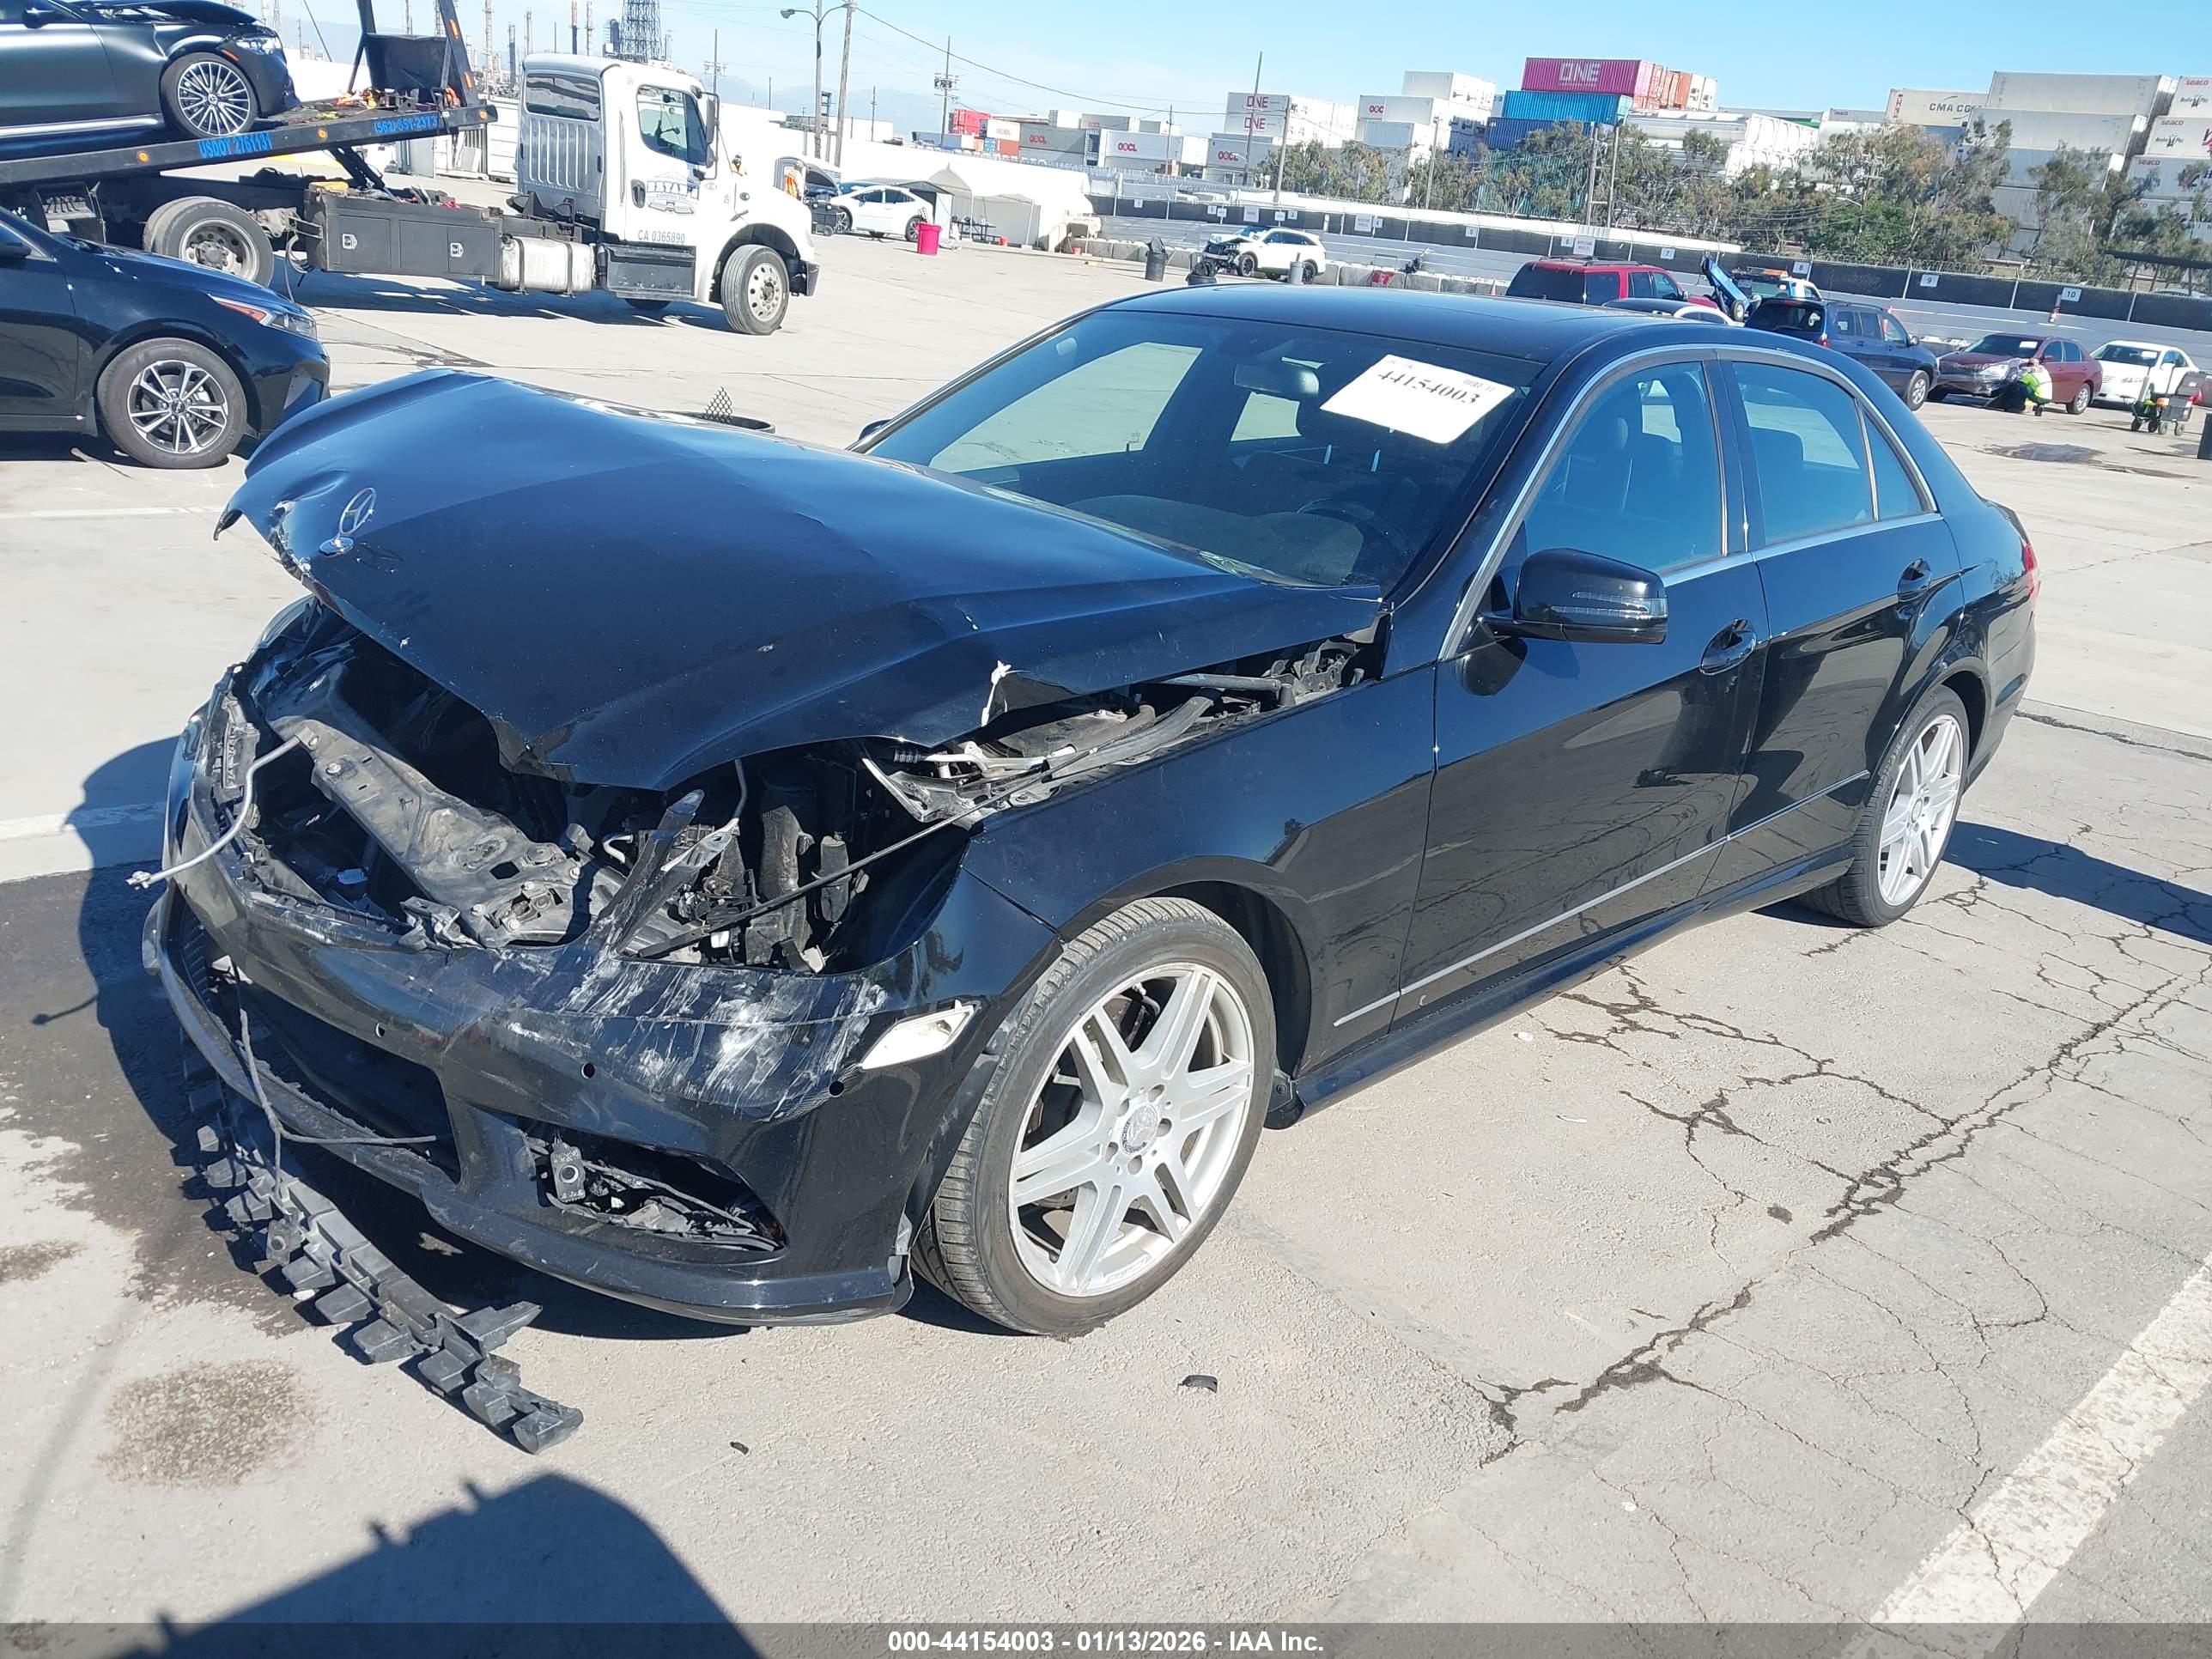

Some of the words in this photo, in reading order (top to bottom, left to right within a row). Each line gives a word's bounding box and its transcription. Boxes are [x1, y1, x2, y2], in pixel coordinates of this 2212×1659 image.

[1559, 62, 1601, 82] ONE
[1247, 95, 1269, 109] ONE
[1929, 102, 1953, 112] CMA
[1244, 117, 1266, 130] ONE
[198, 137, 232, 159] USDOT
[1118, 141, 1138, 152] OOCL
[638, 229, 649, 241] CA
[1377, 370, 1480, 405] 44154003
